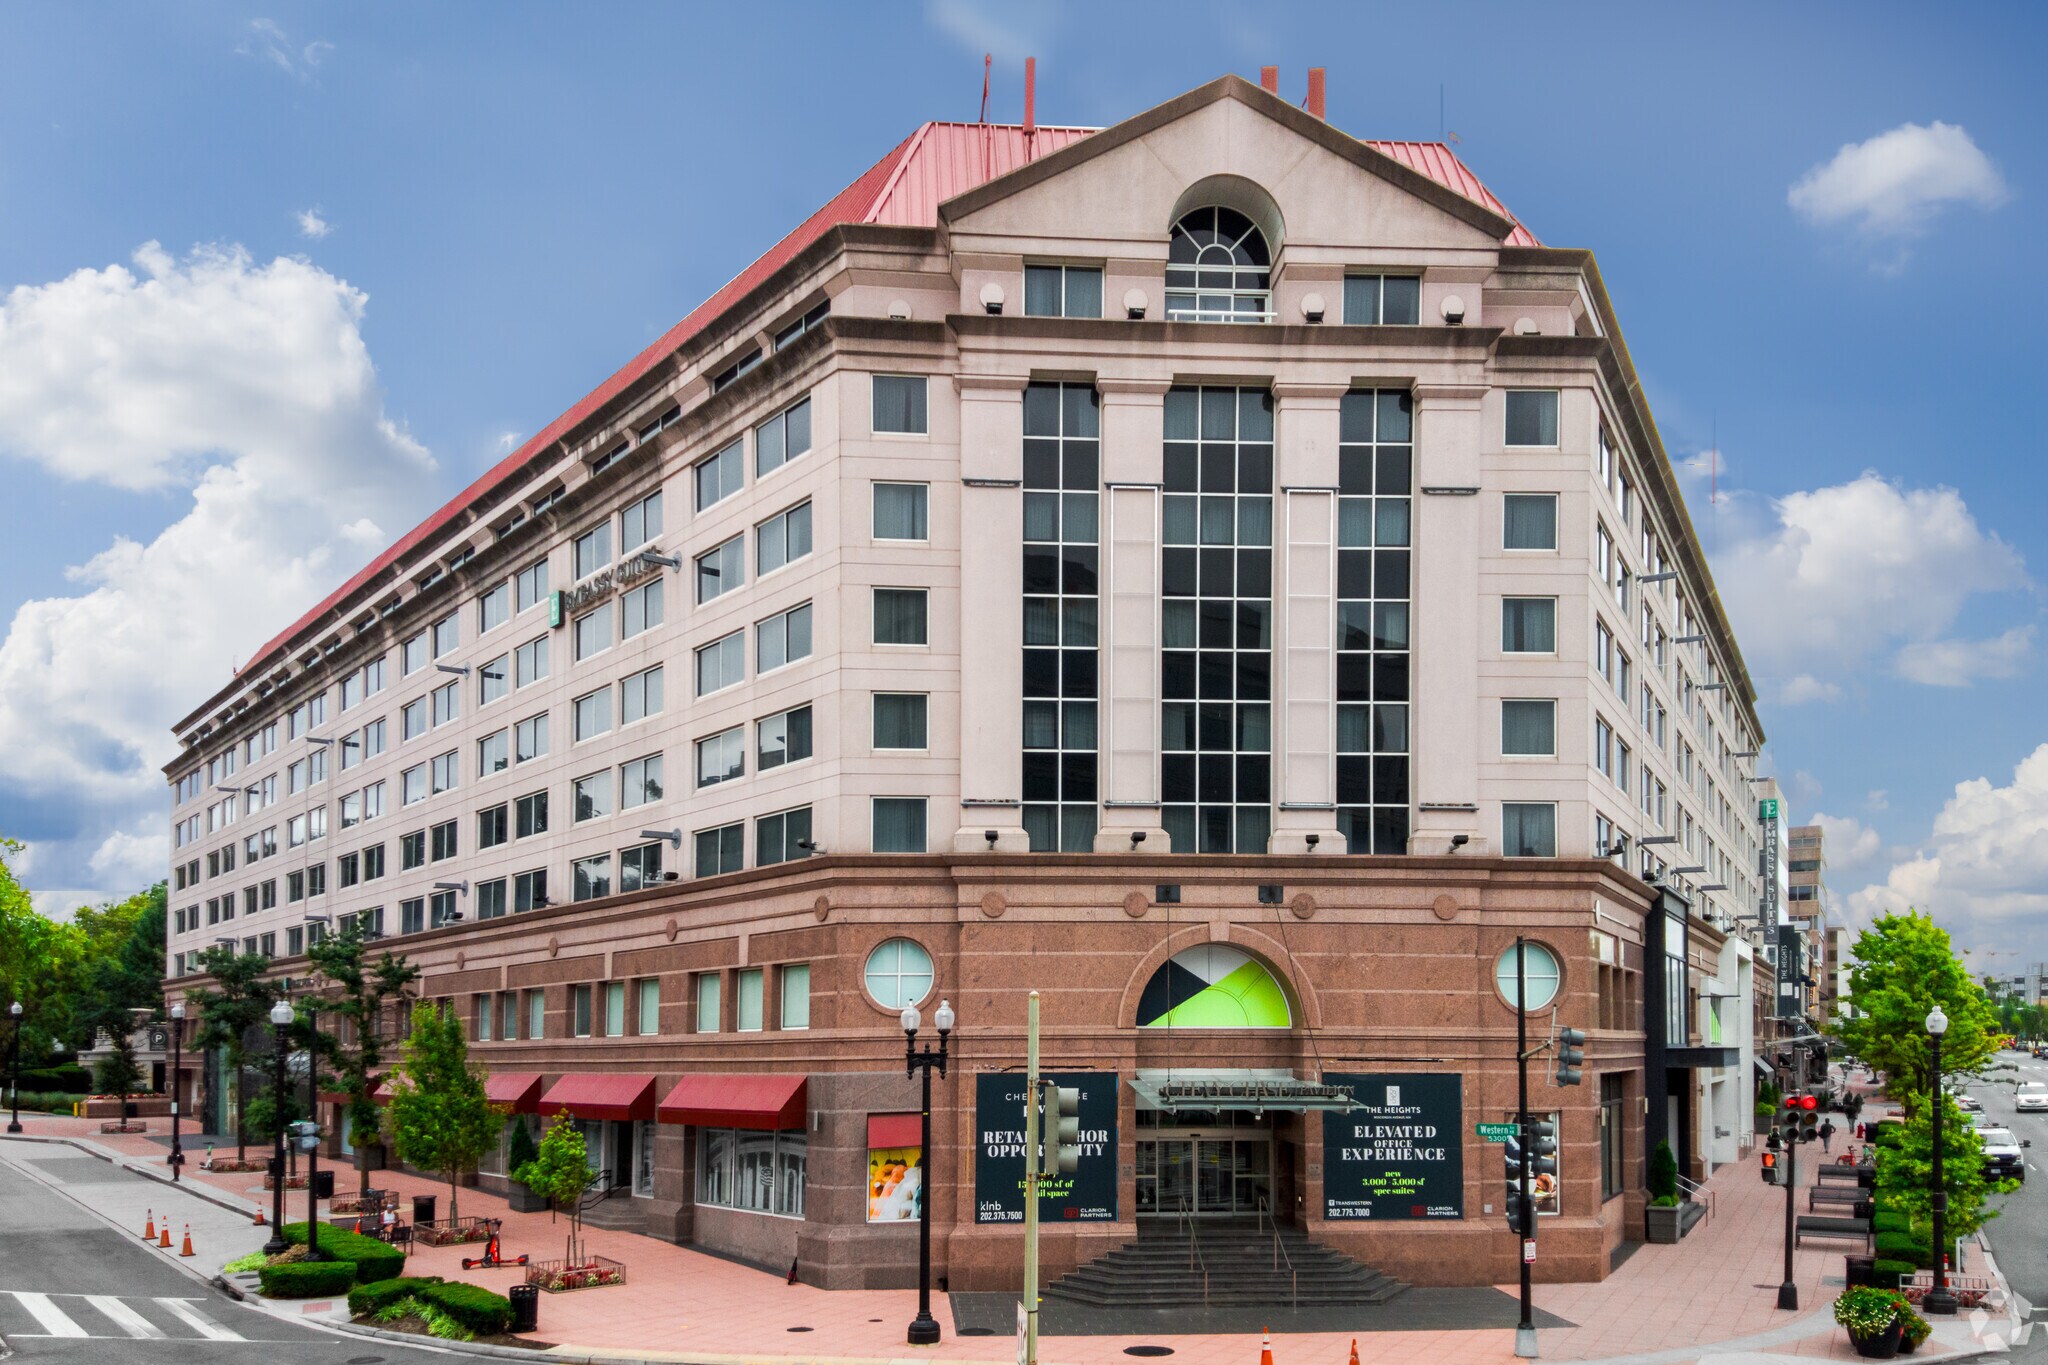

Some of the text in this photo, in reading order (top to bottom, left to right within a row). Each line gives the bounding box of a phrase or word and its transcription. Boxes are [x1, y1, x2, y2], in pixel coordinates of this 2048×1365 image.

[1766, 821, 1776, 879] EMBASSY
[1766, 885, 1776, 934] SUITES
[1005, 1093, 1044, 1101] CHEY
[1366, 1106, 1421, 1114] THE HEIGHTS
[1354, 1125, 1437, 1138] ELEVATED
[1480, 1125, 1509, 1135] Western
[1374, 1139, 1413, 1148] OFFICE
[1341, 1148, 1446, 1161] EXPERIENCE
[1362, 1178, 1387, 1186] 3,000
[1046, 1190, 1069, 1199] space
[1373, 1186, 1415, 1196] spec suites
[980, 1201, 1002, 1211] klnb
